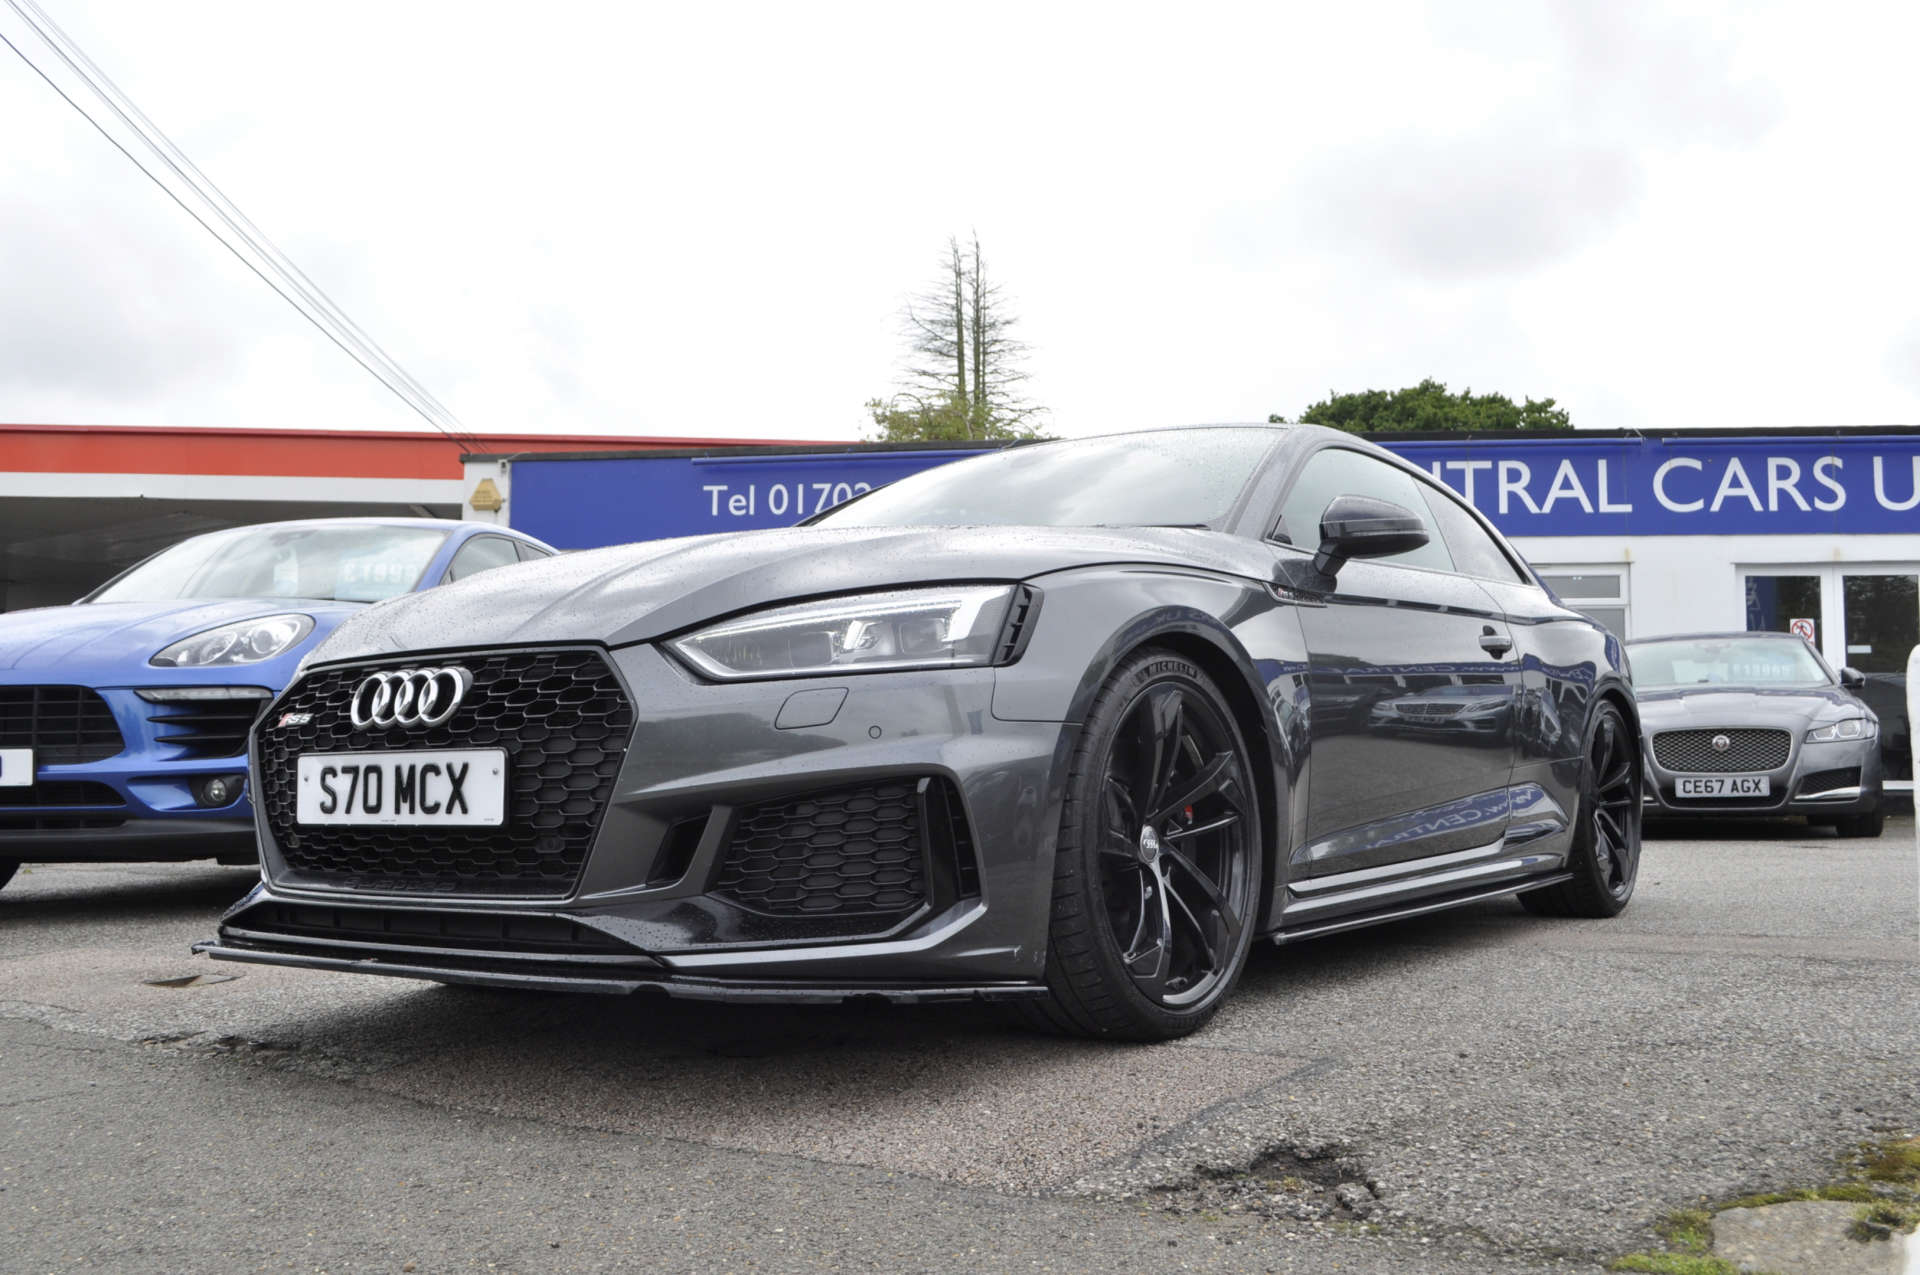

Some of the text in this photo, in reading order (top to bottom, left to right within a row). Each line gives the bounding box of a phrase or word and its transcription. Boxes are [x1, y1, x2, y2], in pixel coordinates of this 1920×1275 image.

[703, 484, 755, 516] Tel
[1653, 456, 1847, 512] CARS
[1873, 456, 1920, 511] U
[320, 762, 470, 815] S70 MCX
[1683, 779, 1762, 793] CE67 AGX
